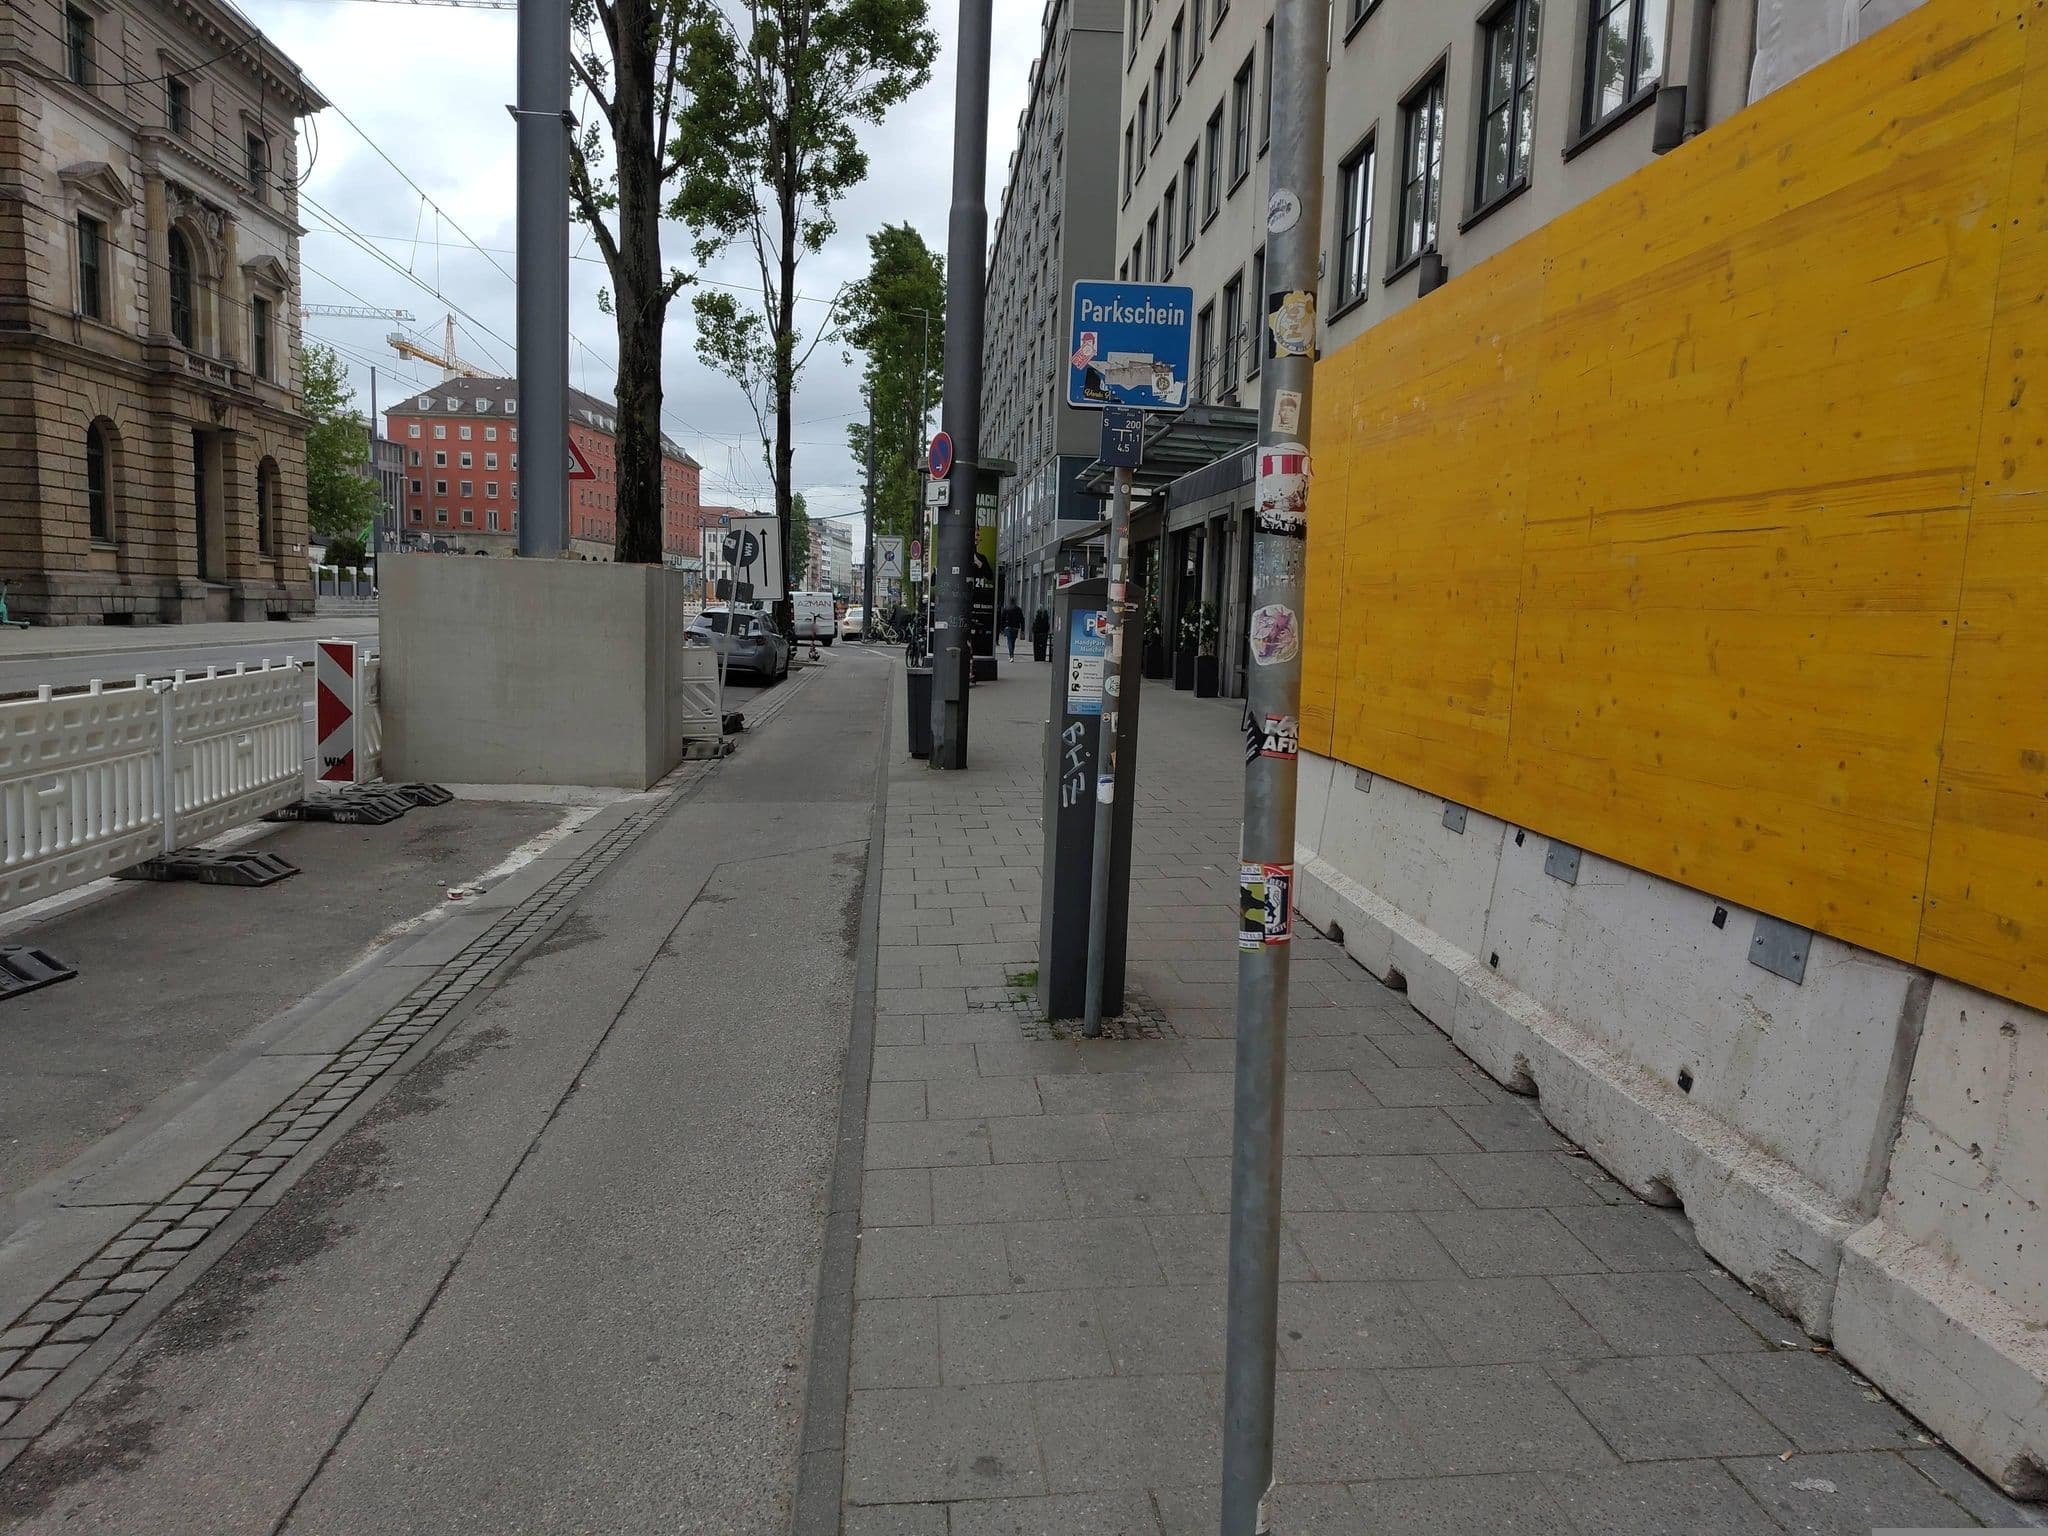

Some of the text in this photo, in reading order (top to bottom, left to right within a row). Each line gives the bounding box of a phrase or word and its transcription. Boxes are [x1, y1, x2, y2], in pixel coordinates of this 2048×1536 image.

[1081, 298, 1185, 326] Parkschein
[1104, 418, 1142, 429] S 200
[1117, 443, 1130, 453] 4.5
[975, 507, 997, 528] SIK
[744, 542, 753, 557] WH
[1262, 735, 1298, 754] AFD
